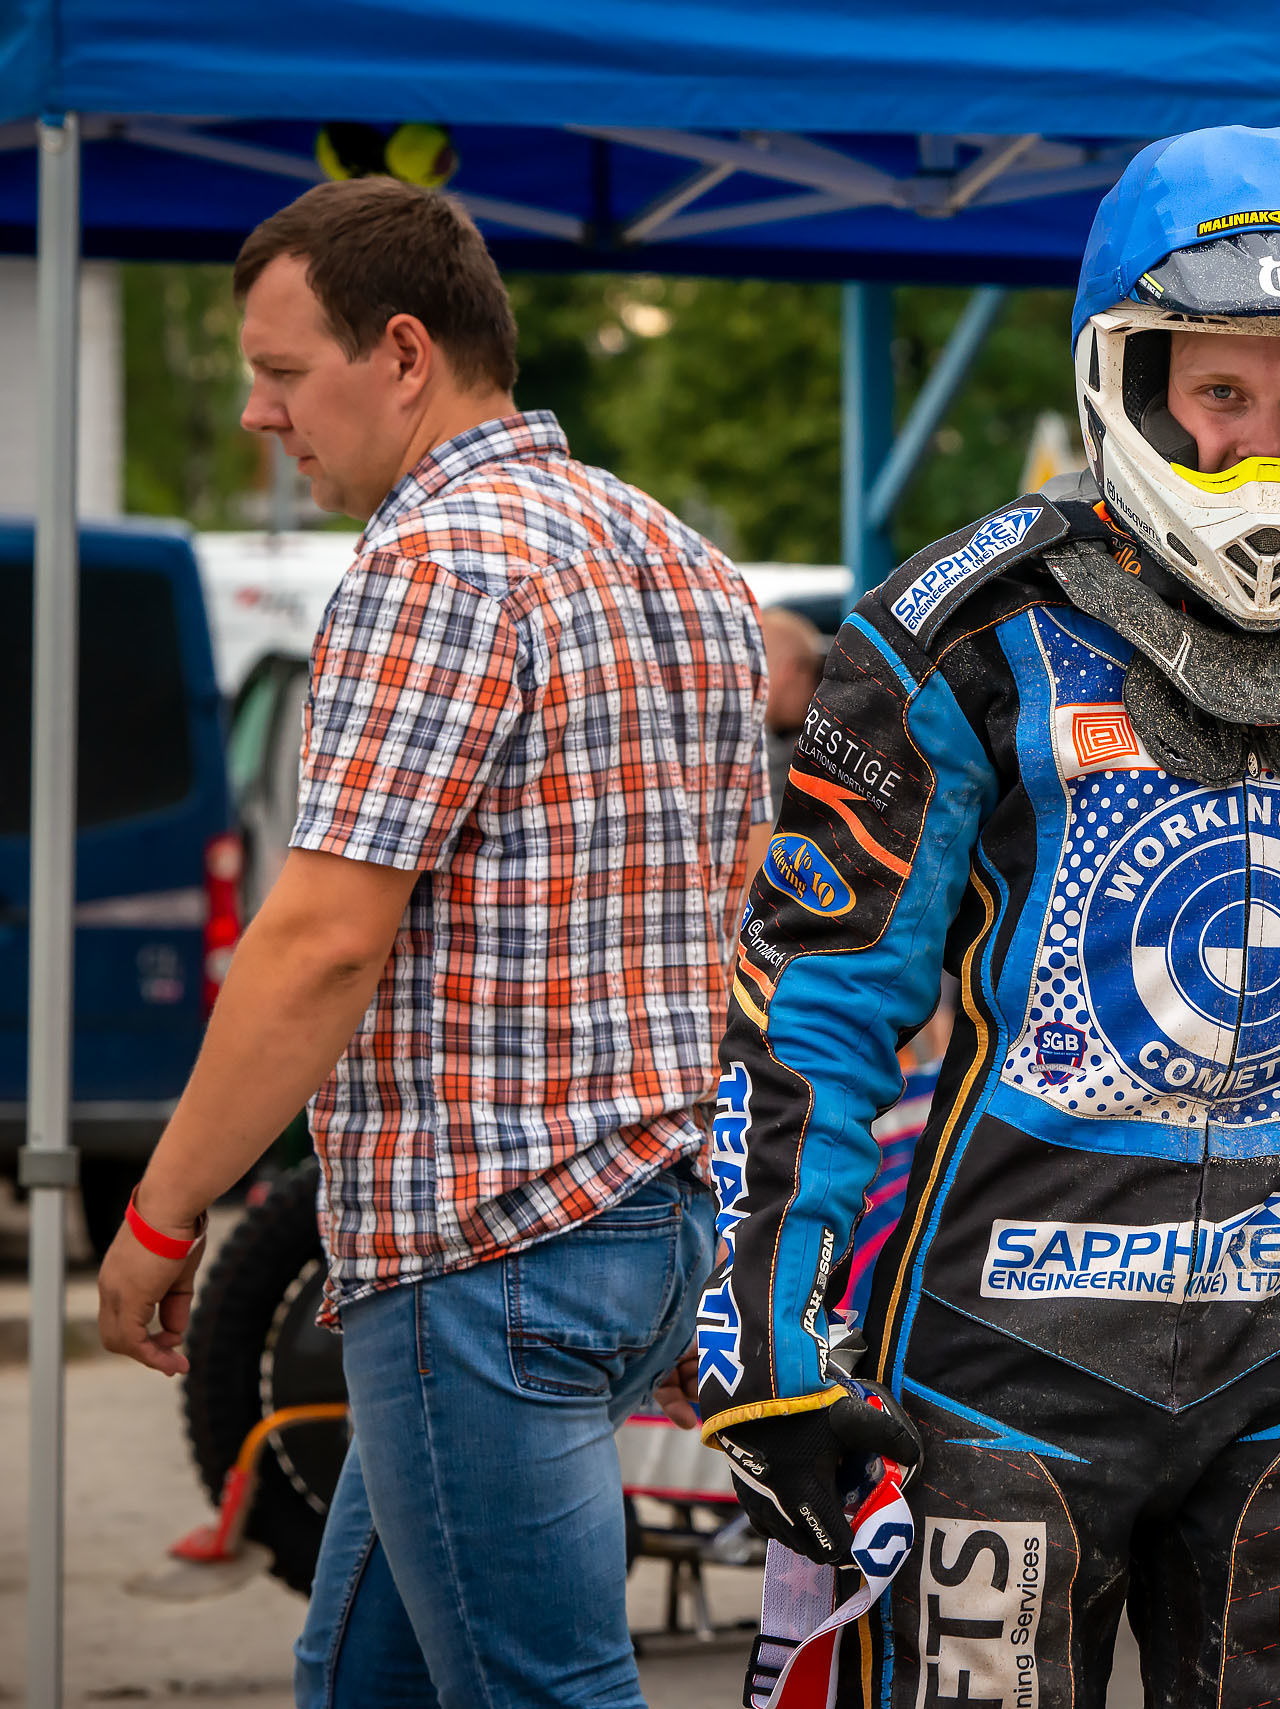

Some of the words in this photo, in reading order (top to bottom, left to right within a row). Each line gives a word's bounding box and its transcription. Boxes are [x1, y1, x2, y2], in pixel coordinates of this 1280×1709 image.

[1199, 211, 1270, 235] MALINIAK
[895, 524, 1012, 624] SAPPHIRE
[908, 567, 973, 631] ENGINEERING
[972, 548, 996, 570] (NE)
[994, 535, 1018, 551] LTD
[805, 703, 902, 798] RESTIGE
[837, 768, 866, 796] NORTH
[865, 791, 889, 813] EAST
[770, 838, 807, 900] Catering
[788, 842, 813, 872] No
[811, 871, 836, 908] 10
[1041, 1030, 1079, 1051] SGB
[987, 1269, 1176, 1294] ENGINEERING
[1185, 1273, 1228, 1297] (NE)
[1237, 1270, 1279, 1293] LTD
[799, 1505, 833, 1551] JTRACING
[1010, 1537, 1040, 1646] Services
